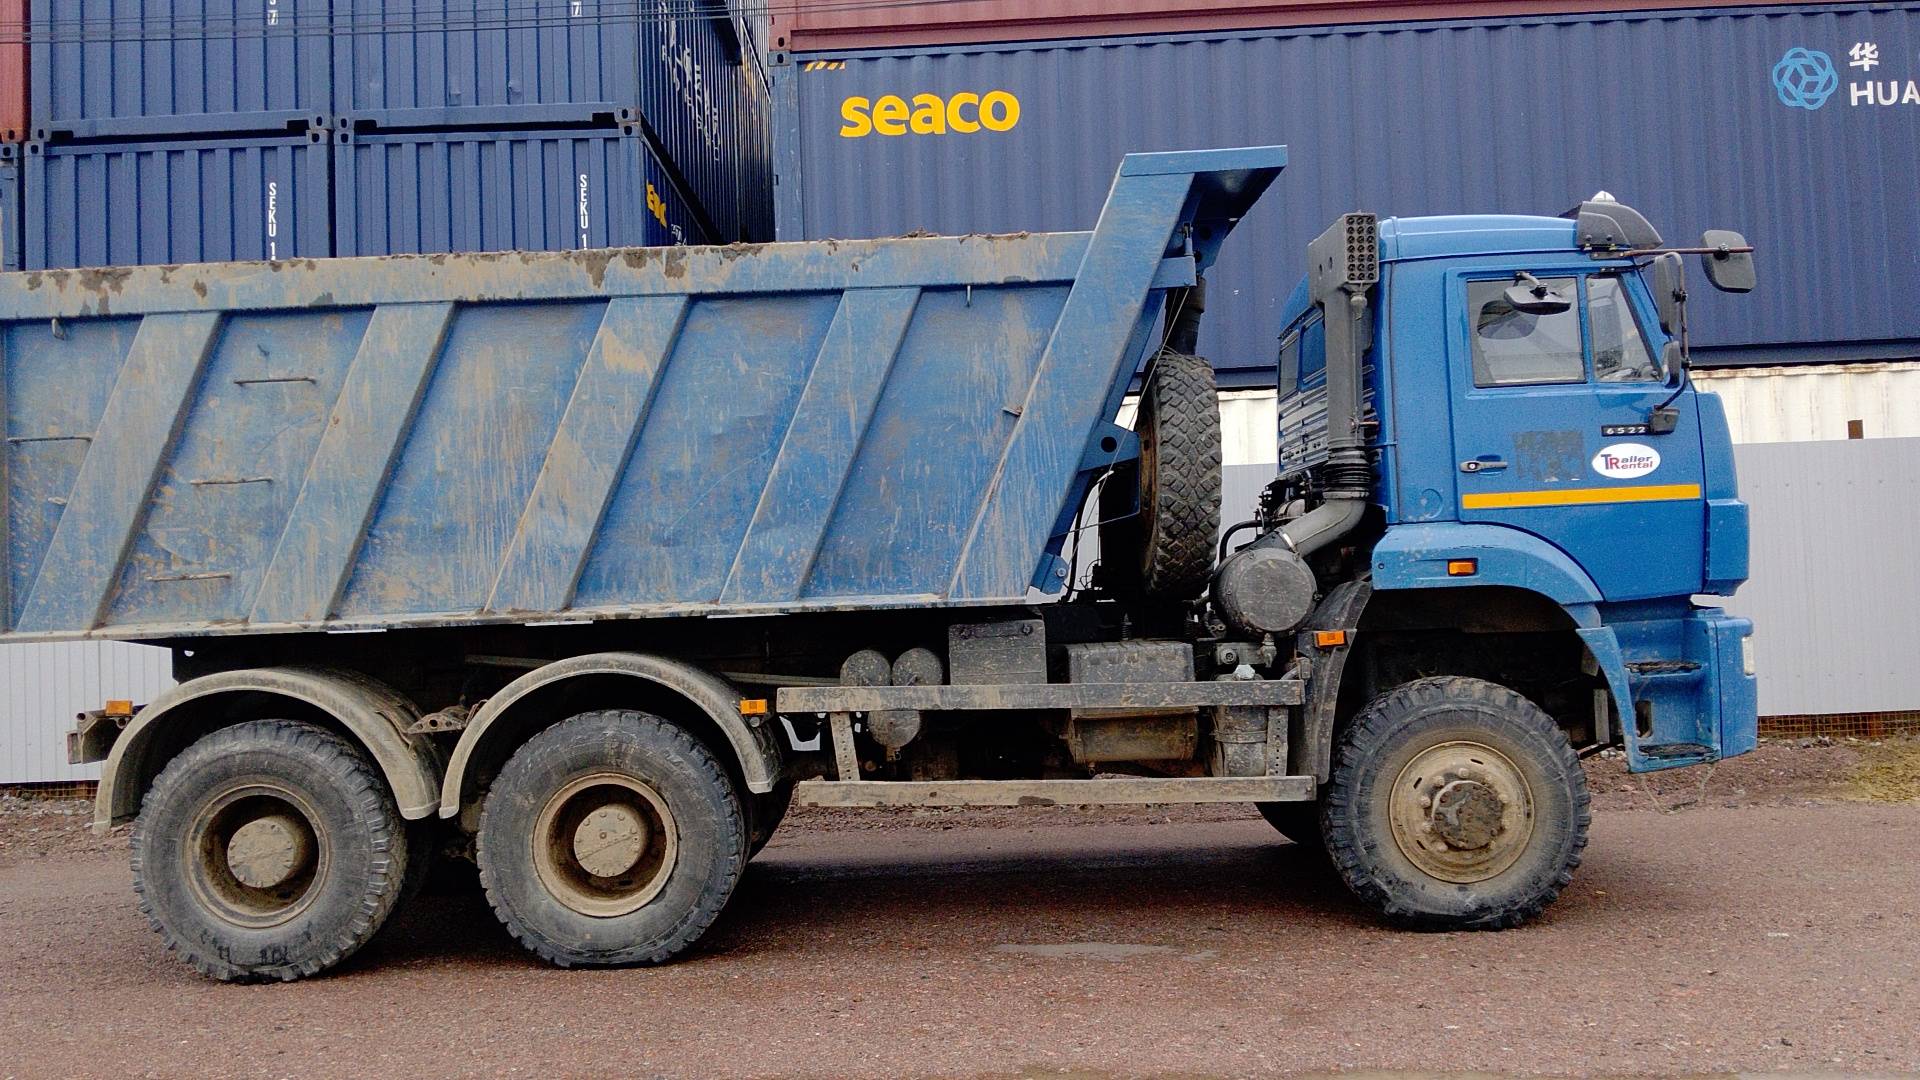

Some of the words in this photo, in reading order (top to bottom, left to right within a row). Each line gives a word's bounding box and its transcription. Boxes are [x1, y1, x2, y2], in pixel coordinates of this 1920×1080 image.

[571, 1, 582, 17] 7
[1848, 41, 1880, 72] 华
[839, 89, 1021, 138] seaco
[268, 182, 277, 237] SEKU
[579, 174, 589, 229] SEKU
[1606, 426, 1646, 435] 6522
